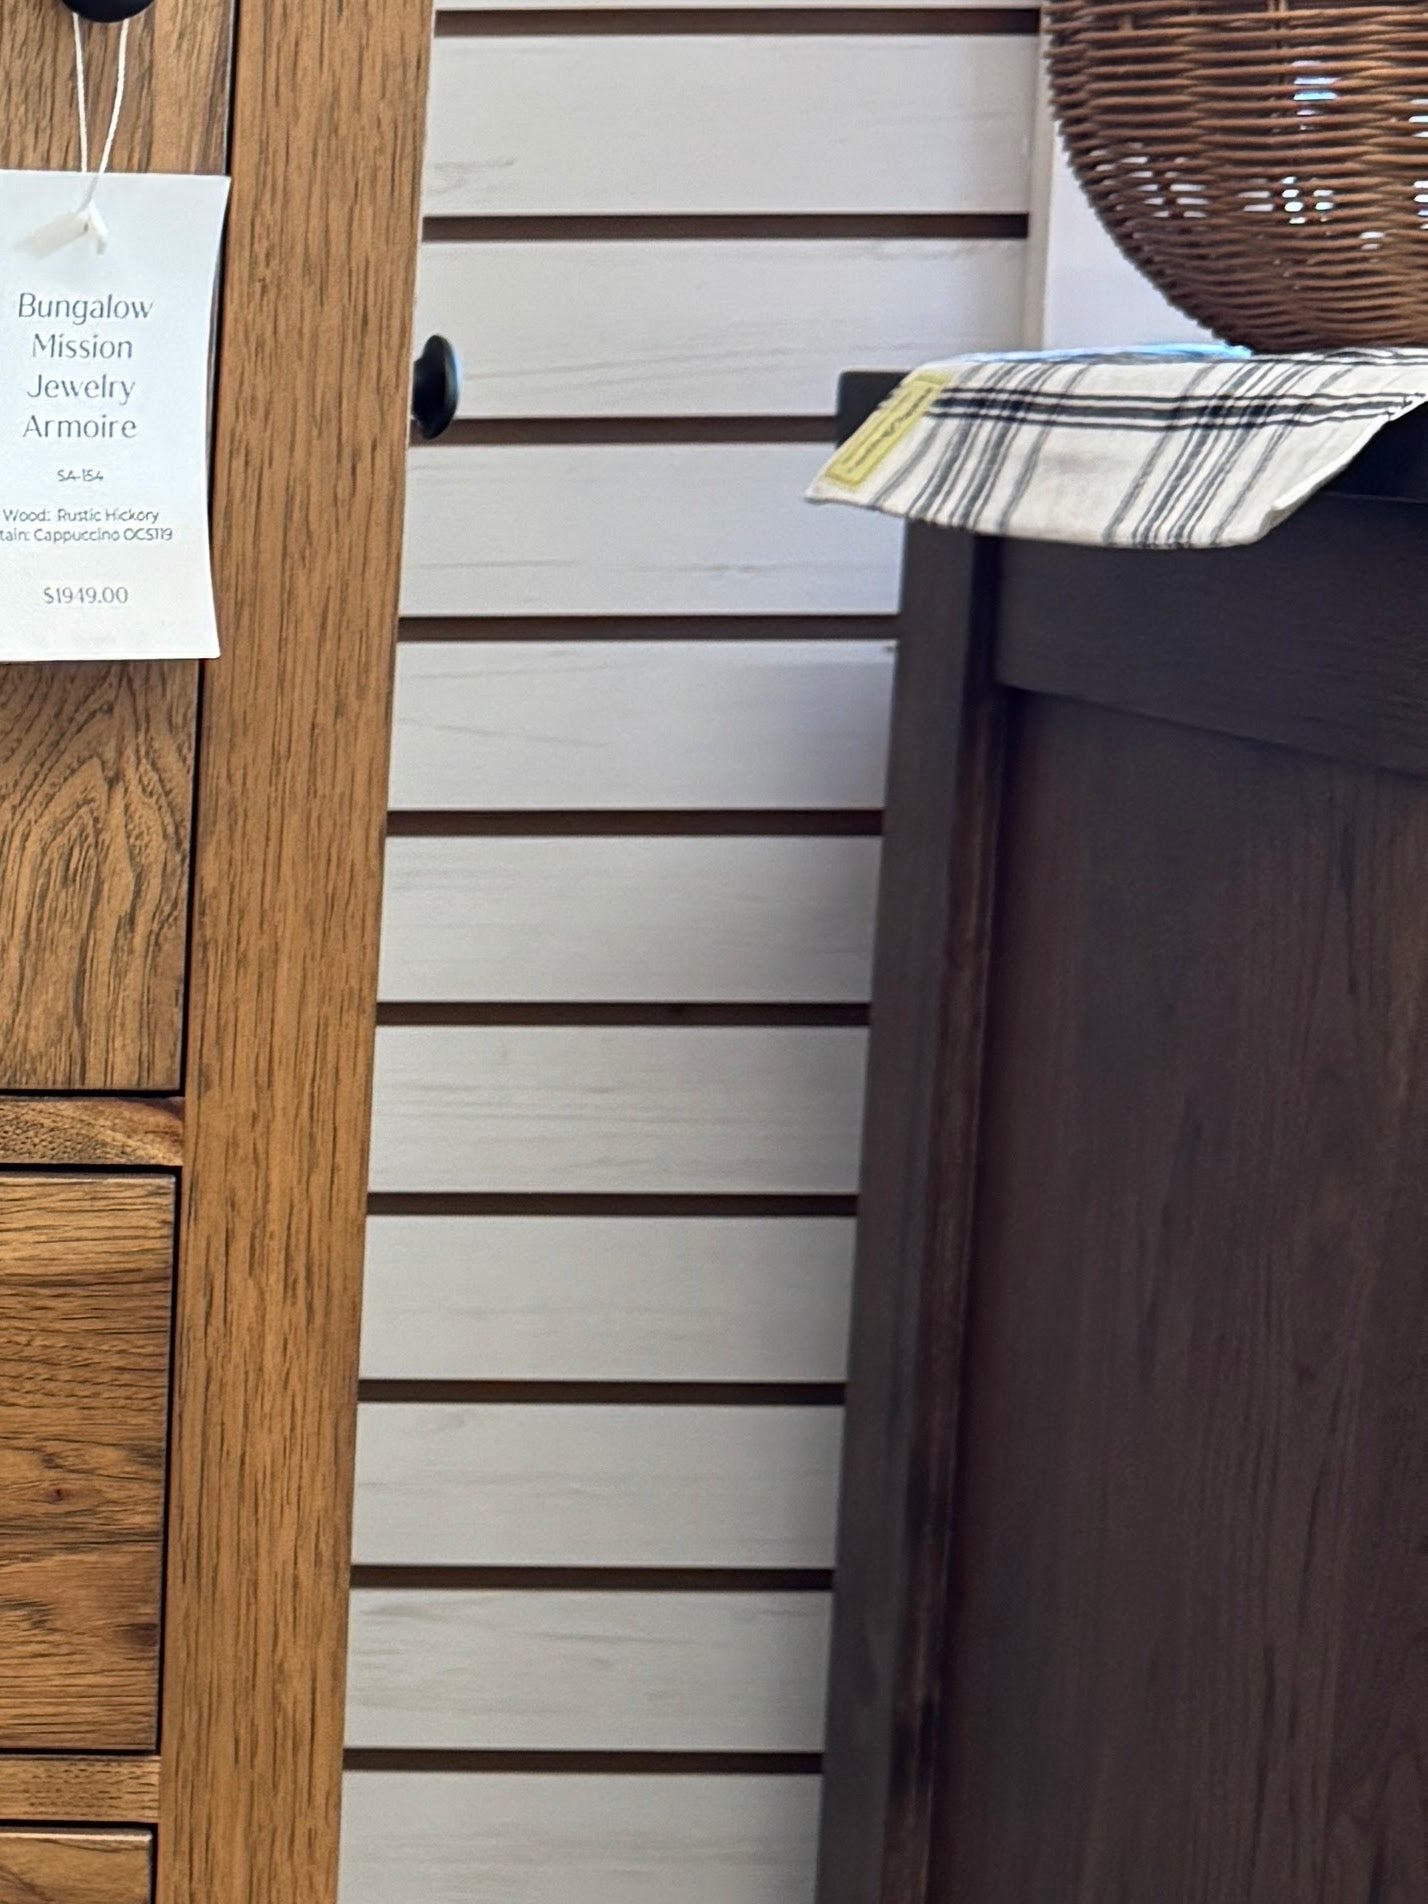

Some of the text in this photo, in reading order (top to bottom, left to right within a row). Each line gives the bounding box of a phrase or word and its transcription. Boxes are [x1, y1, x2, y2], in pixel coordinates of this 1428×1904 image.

[18, 292, 154, 325] Bungalow
[32, 333, 133, 359] Mission
[27, 374, 136, 406] Jewelry
[22, 414, 137, 439] Armoire
[2, 508, 159, 524] Wood: Rustic Hickory
[33, 528, 120, 544] Cappuccino
